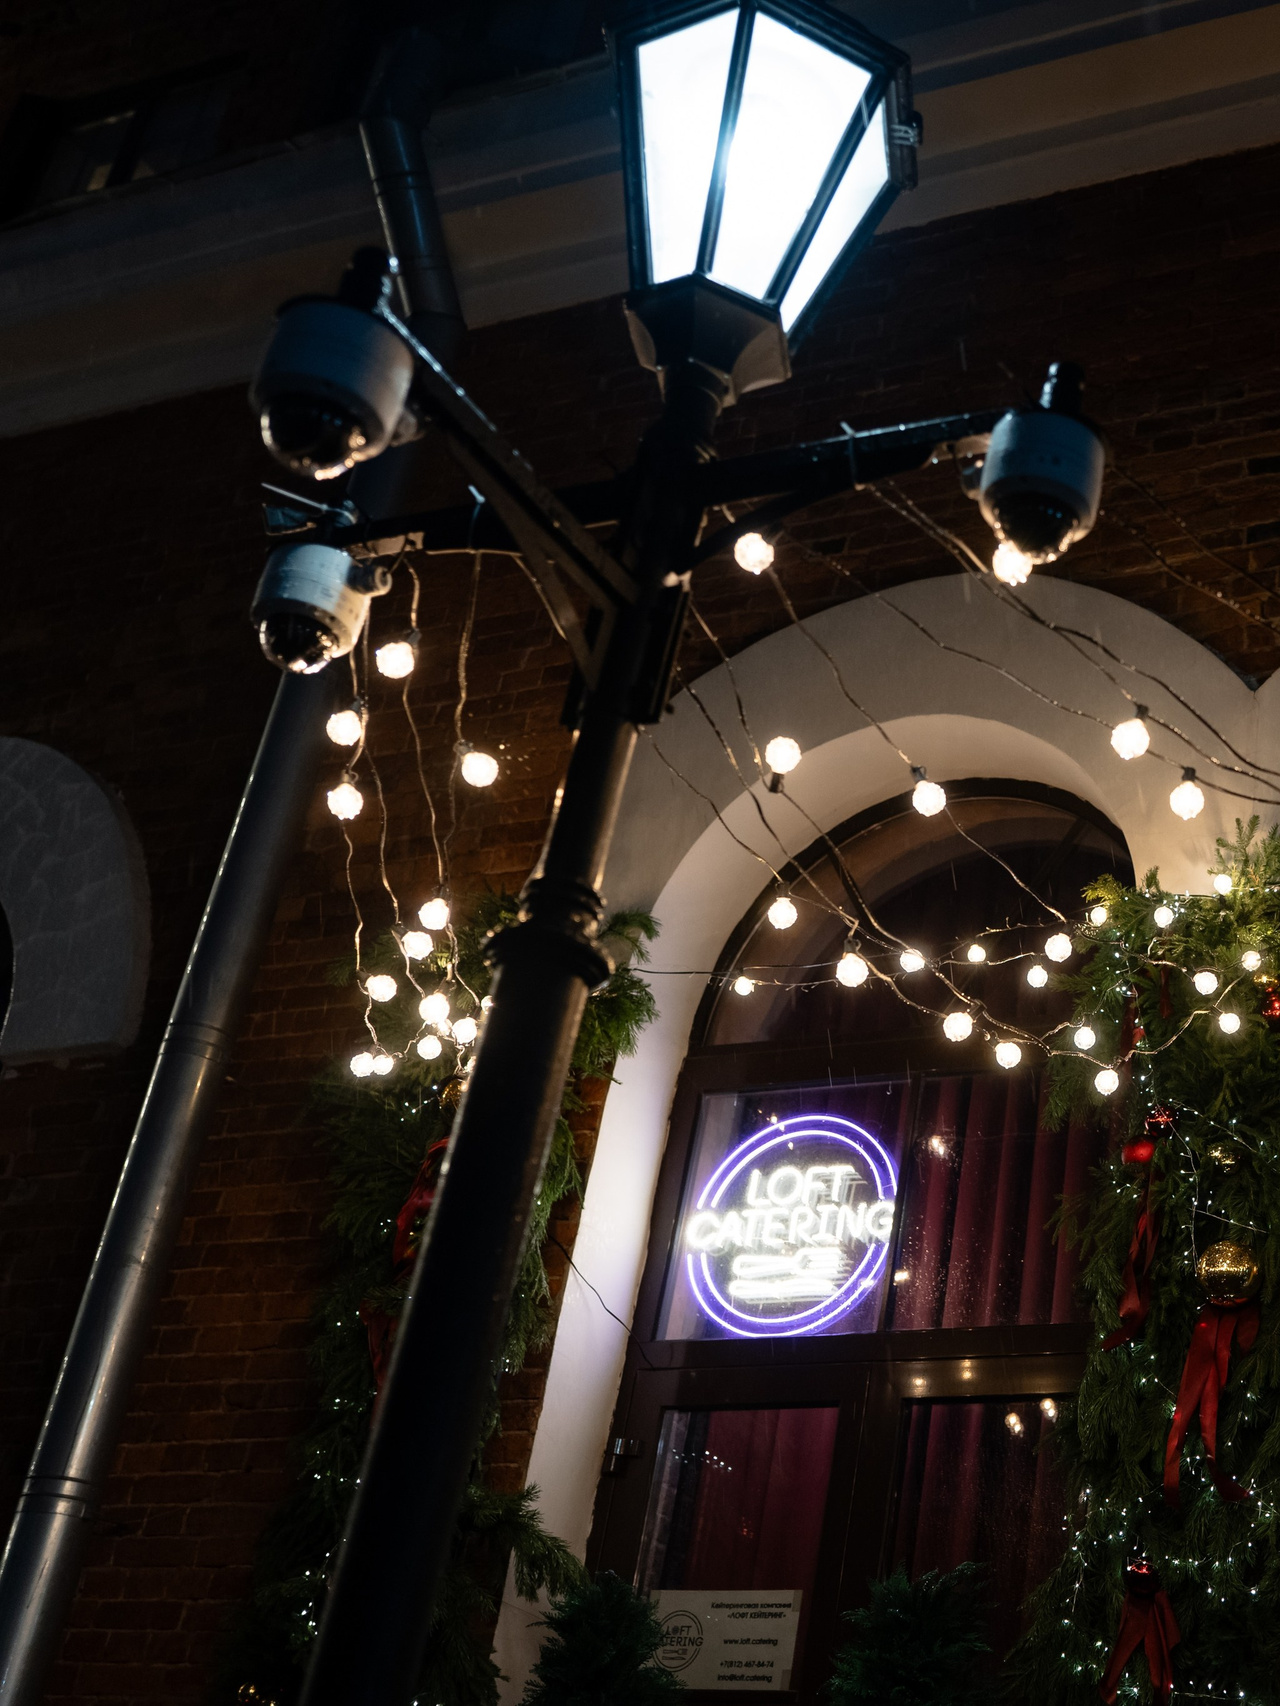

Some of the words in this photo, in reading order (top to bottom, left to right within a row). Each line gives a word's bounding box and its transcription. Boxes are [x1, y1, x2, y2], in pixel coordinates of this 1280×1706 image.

[747, 1165, 857, 1207] LOFT
[686, 1200, 895, 1248] CATERING
[665, 1625, 692, 1636] LOFT
[658, 1636, 703, 1647] TERING
[723, 1638, 778, 1646] www.loft.catering
